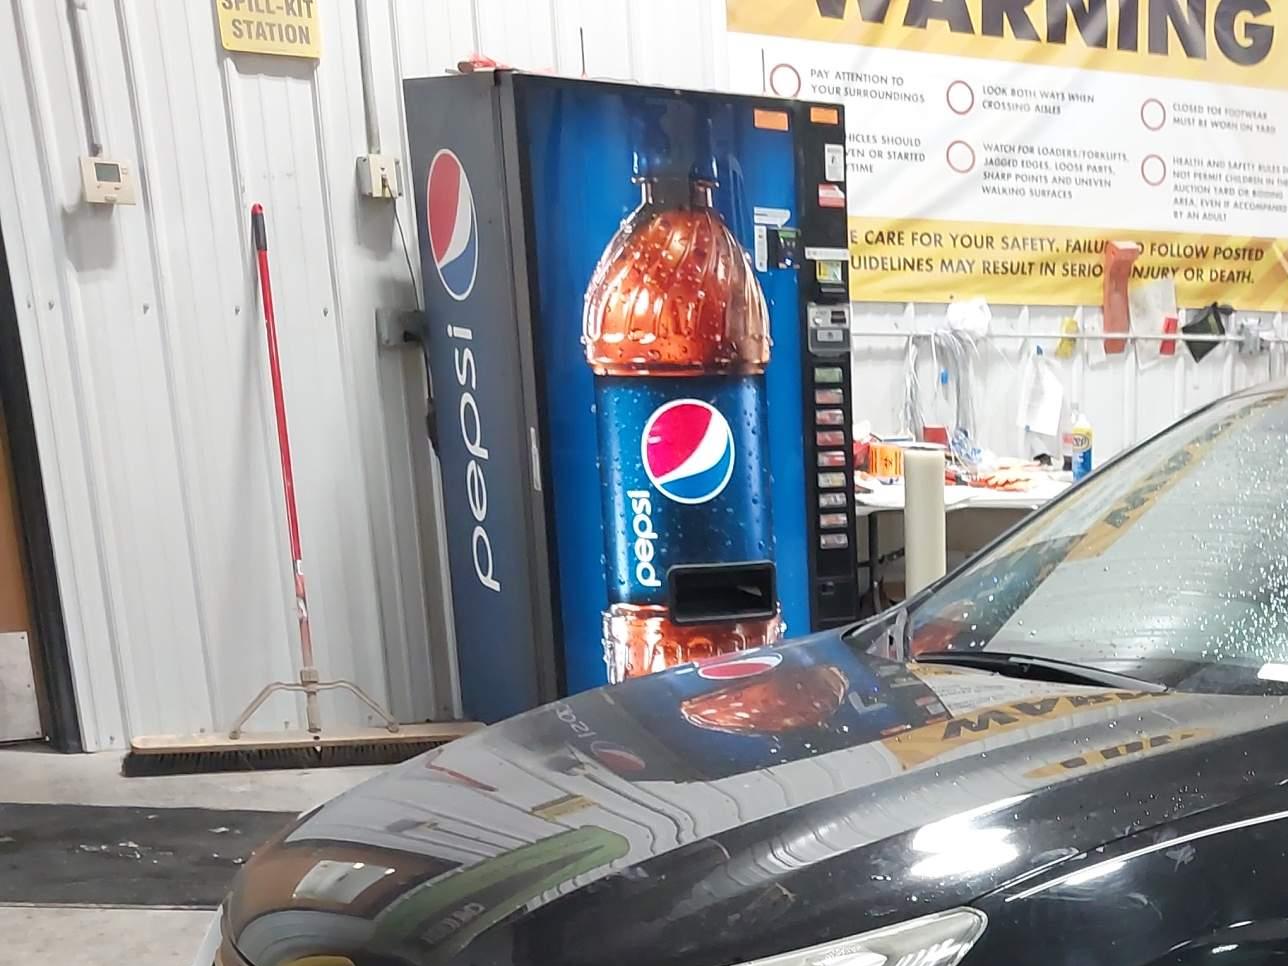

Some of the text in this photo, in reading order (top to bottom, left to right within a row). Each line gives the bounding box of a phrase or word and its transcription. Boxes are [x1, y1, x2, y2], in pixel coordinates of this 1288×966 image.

[231, 18, 311, 44] STATION
[810, 68, 904, 86] PAY ATTENTION TO
[811, 84, 925, 103] YOUR SURROUNDINGS
[982, 85, 1095, 103] LOOK BOTH WAYS WHEN
[982, 100, 1031, 113] CROSSING
[1172, 103, 1204, 114] CLOSED
[1224, 107, 1268, 120] FOOTWEAR
[1172, 116, 1195, 126] MUST
[1210, 120, 1238, 131] WORN
[1240, 123, 1253, 132] ON
[881, 135, 921, 147] SHOULD
[982, 143, 1016, 154] WATCH
[1017, 144, 1035, 155] FOR
[869, 149, 884, 160] OR
[887, 151, 926, 162] STARTED
[984, 157, 1018, 168] JAGGED
[1055, 161, 1084, 172] LOOSE
[1172, 156, 1204, 167] HEALTH
[1206, 158, 1225, 169] AND
[1227, 161, 1256, 172] SAFETY
[983, 171, 1112, 188] SHARP POINTS AND UNEVEN
[1172, 170, 1190, 180] NOT
[1193, 171, 1223, 182] PERMIT
[1225, 173, 1264, 185] CHILDREN
[982, 185, 1073, 200] WALKING SURFACES
[1173, 183, 1210, 195] AUCTION
[1213, 186, 1236, 196] YARD
[1200, 198, 1221, 208] EVEN
[1187, 211, 1199, 220] AN
[1202, 212, 1227, 222] ADULT
[864, 230, 905, 246] CARE
[911, 232, 943, 248] FOR
[949, 234, 995, 250] YOUR
[1150, 243, 1210, 259] FOLLOW
[1213, 246, 1265, 262] POSTED
[850, 255, 934, 272] UIDELINES
[940, 258, 976, 274] MAY
[982, 260, 1036, 277] RESULT
[1039, 262, 1056, 277] IN
[1062, 262, 1103, 278] SERIO
[1183, 266, 1204, 281] OR
[1209, 268, 1255, 284] DEATH.
[447, 323, 501, 592] pepsi
[626, 489, 662, 588] pepsi
